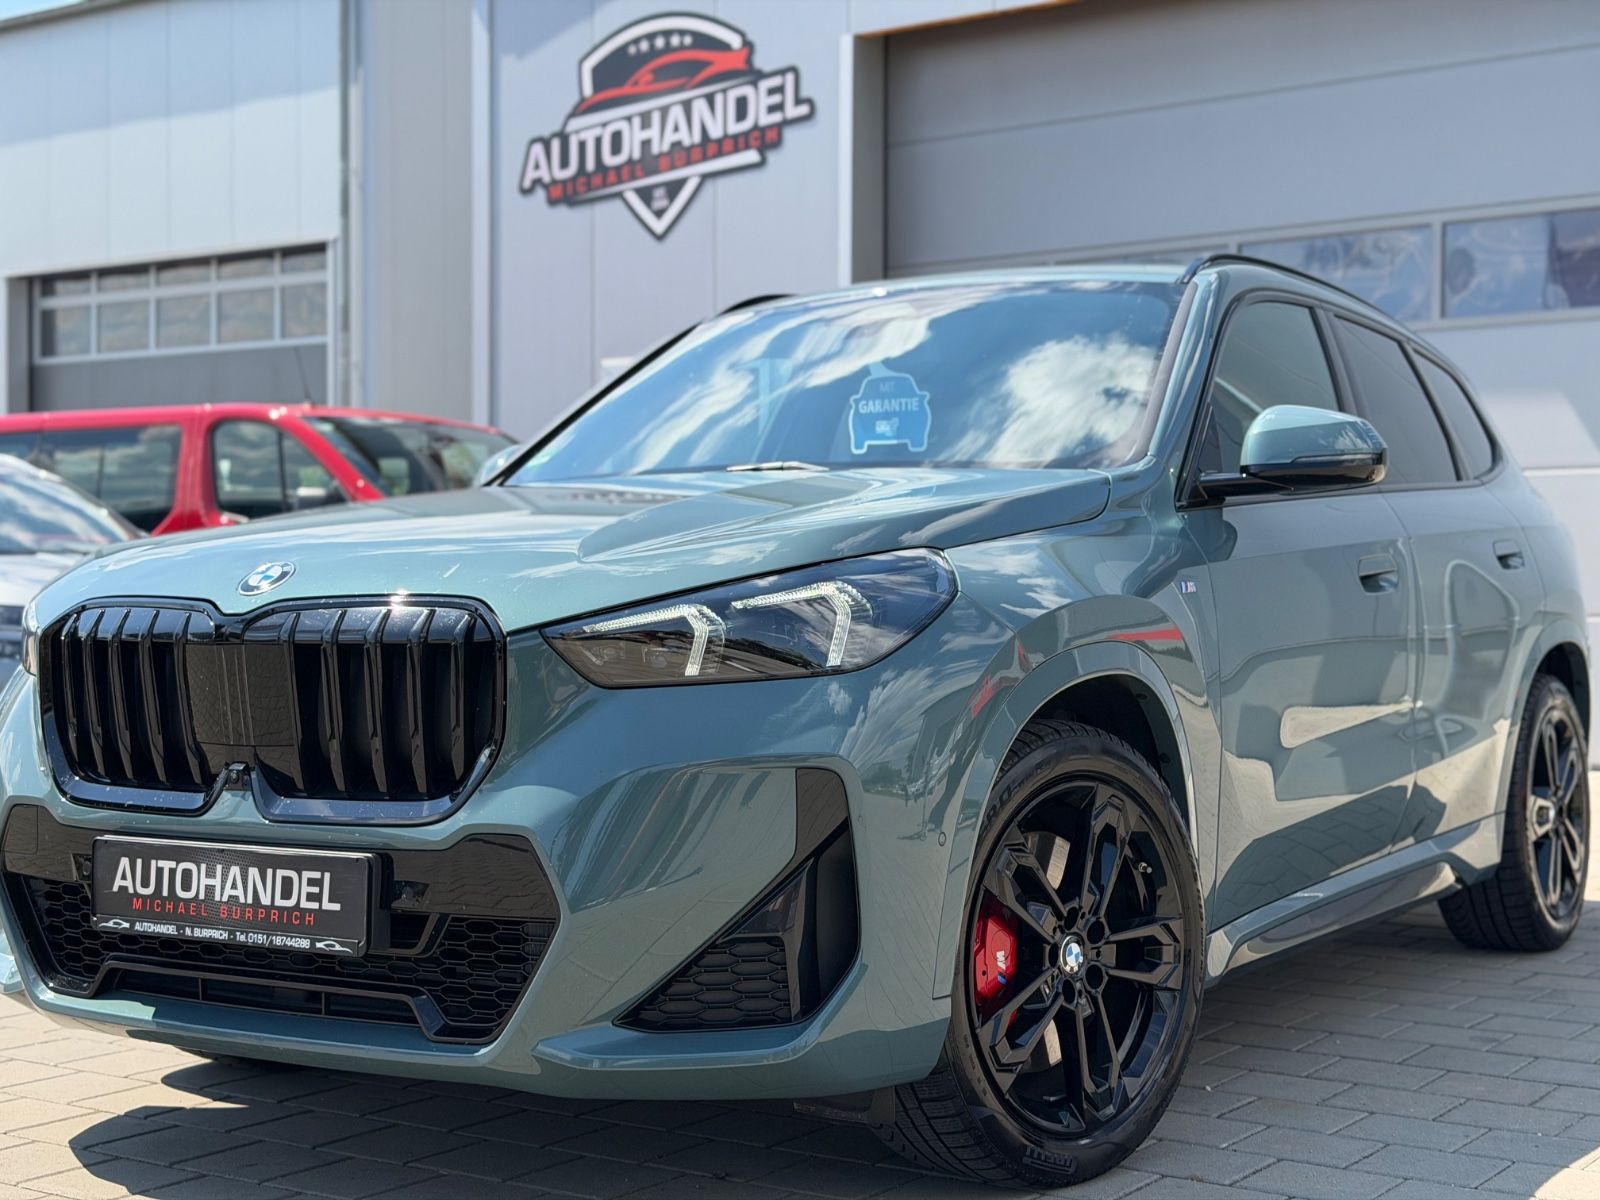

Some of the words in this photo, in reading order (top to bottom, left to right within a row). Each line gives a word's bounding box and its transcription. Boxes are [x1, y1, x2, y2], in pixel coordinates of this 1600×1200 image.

[521, 71, 811, 190] AUTOHANDEL
[549, 163, 645, 199] MICHAEL
[858, 398, 920, 414] GARANTIE
[112, 857, 341, 911] AUTOHANDEL
[132, 898, 208, 917] MICHAEL
[220, 907, 315, 926] BURPRICH
[134, 922, 178, 935] AUTOHANDEL
[194, 928, 228, 940] BURPRICH
